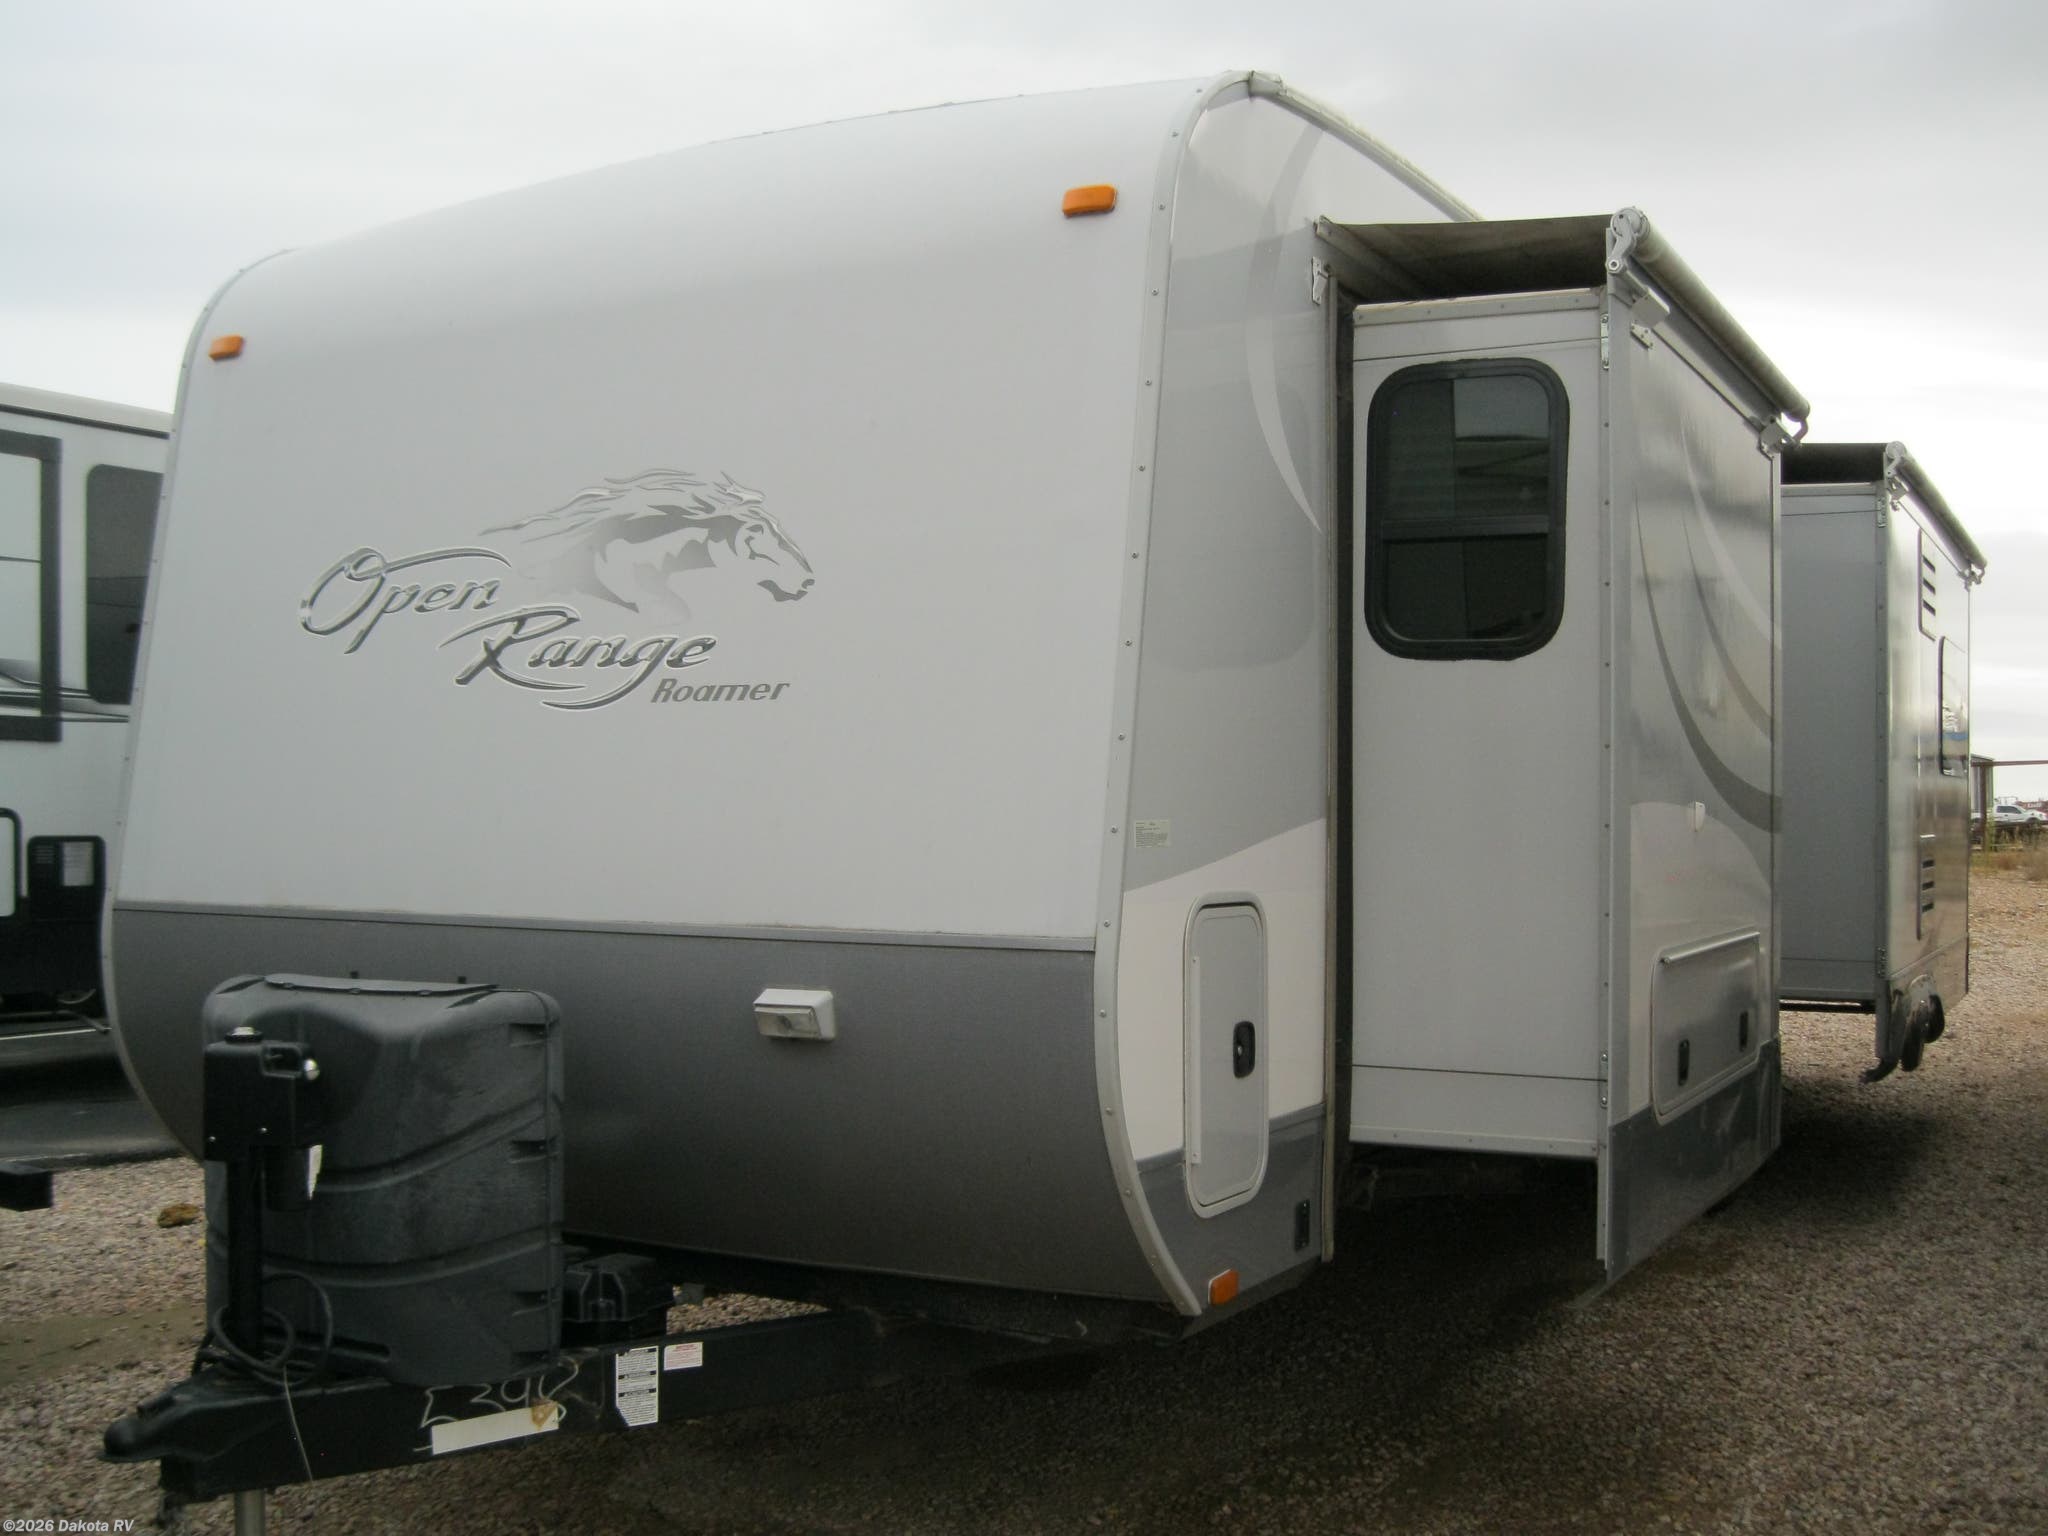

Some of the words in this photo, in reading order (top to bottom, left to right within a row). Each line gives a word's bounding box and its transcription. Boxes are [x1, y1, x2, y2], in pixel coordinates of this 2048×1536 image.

[301, 546, 512, 656] Open
[438, 603, 718, 711] Range
[650, 678, 791, 704] Roamer
